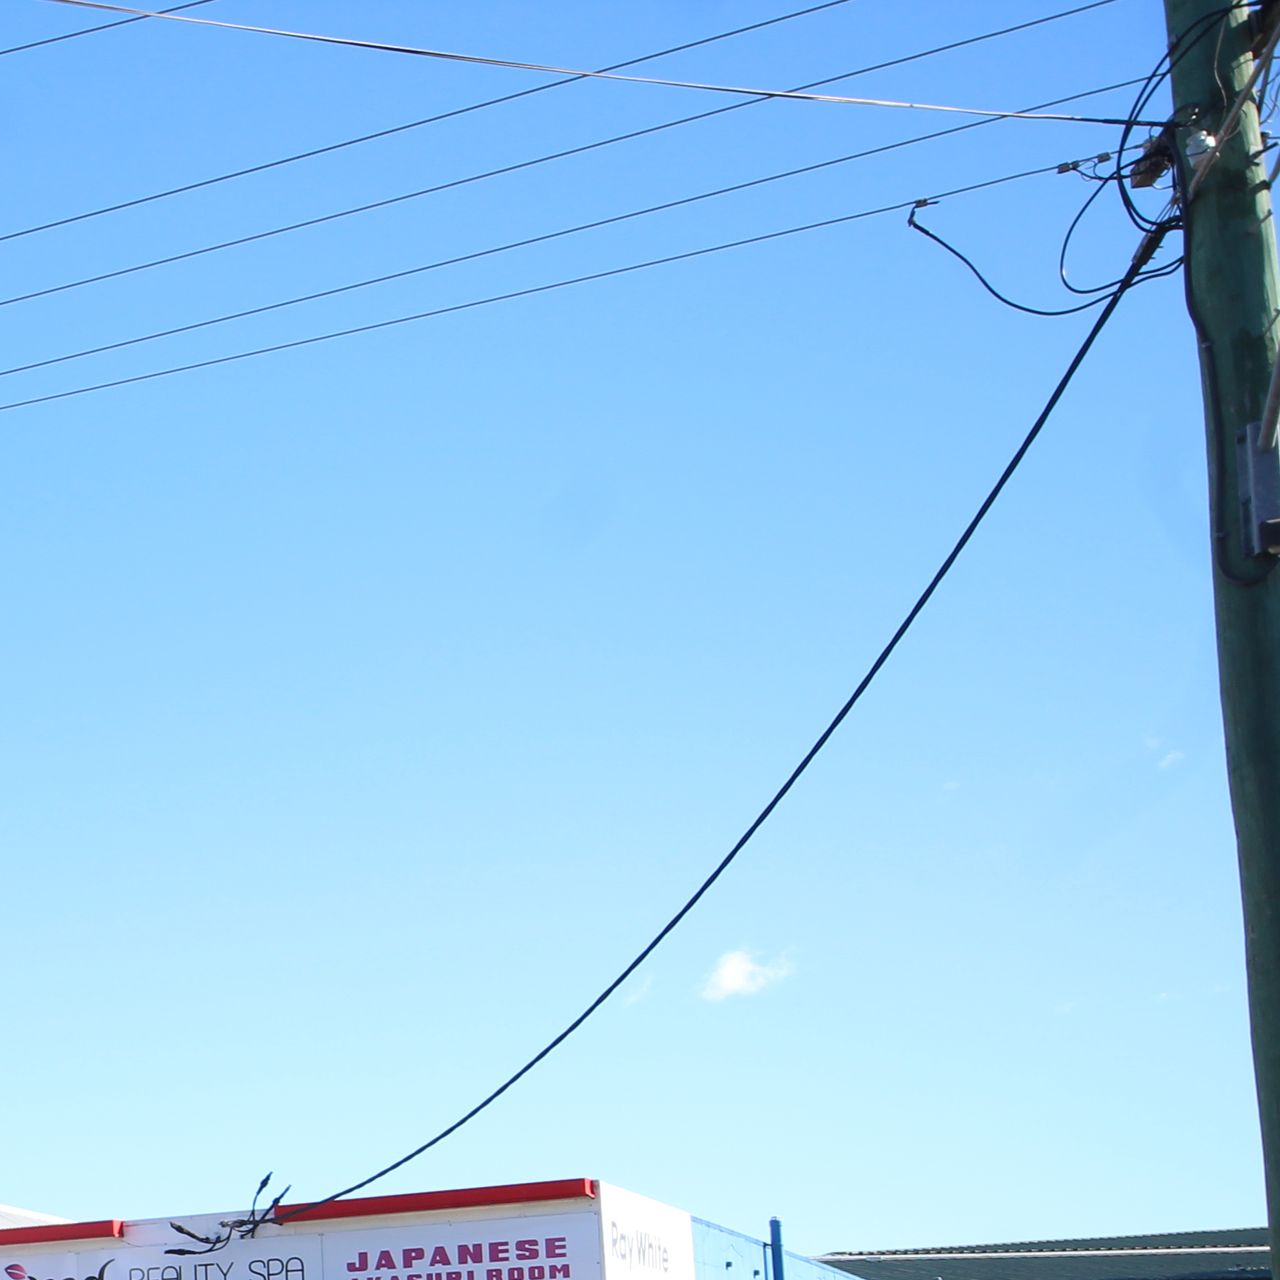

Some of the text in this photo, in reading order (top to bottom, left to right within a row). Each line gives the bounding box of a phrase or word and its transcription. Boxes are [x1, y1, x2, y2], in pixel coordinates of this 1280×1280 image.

[346, 1237, 567, 1272] JAPANESE
[610, 1220, 670, 1273] Ray White
